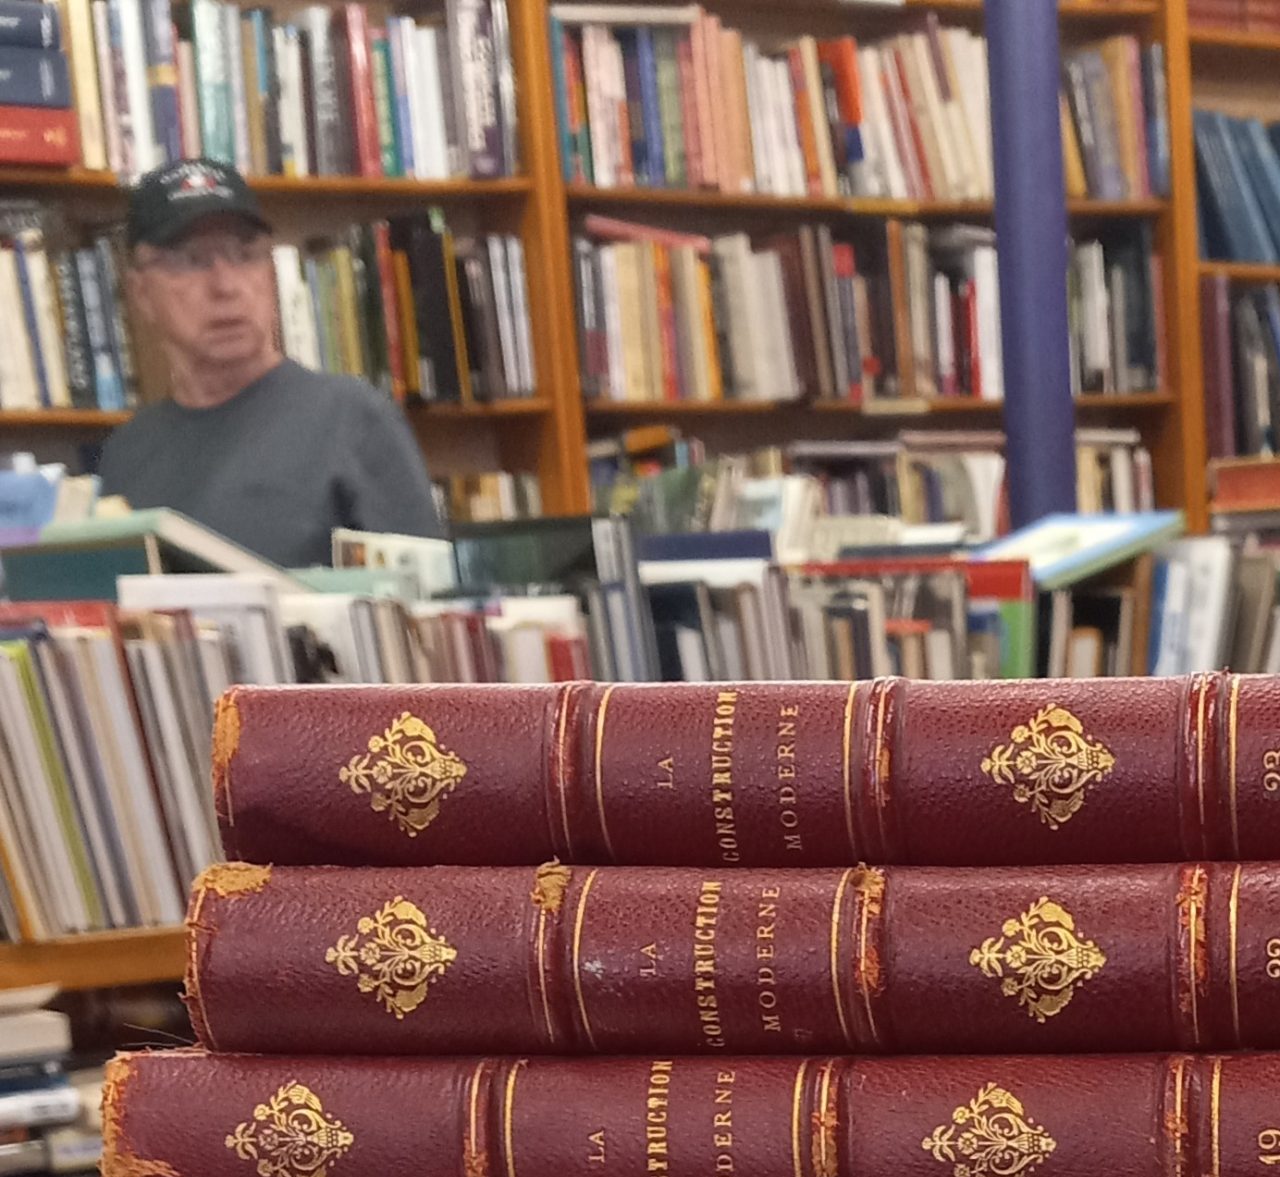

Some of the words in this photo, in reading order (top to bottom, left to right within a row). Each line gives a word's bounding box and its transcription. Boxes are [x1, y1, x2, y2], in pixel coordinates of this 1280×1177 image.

[657, 757, 673, 788] LA
[712, 691, 739, 863] CONSTRUCTION
[777, 704, 802, 850] MODERNE
[639, 942, 656, 977] LA
[694, 881, 724, 1047] CONSTRUCTION
[757, 886, 780, 1031] MODERNE
[588, 1130, 605, 1163] LA
